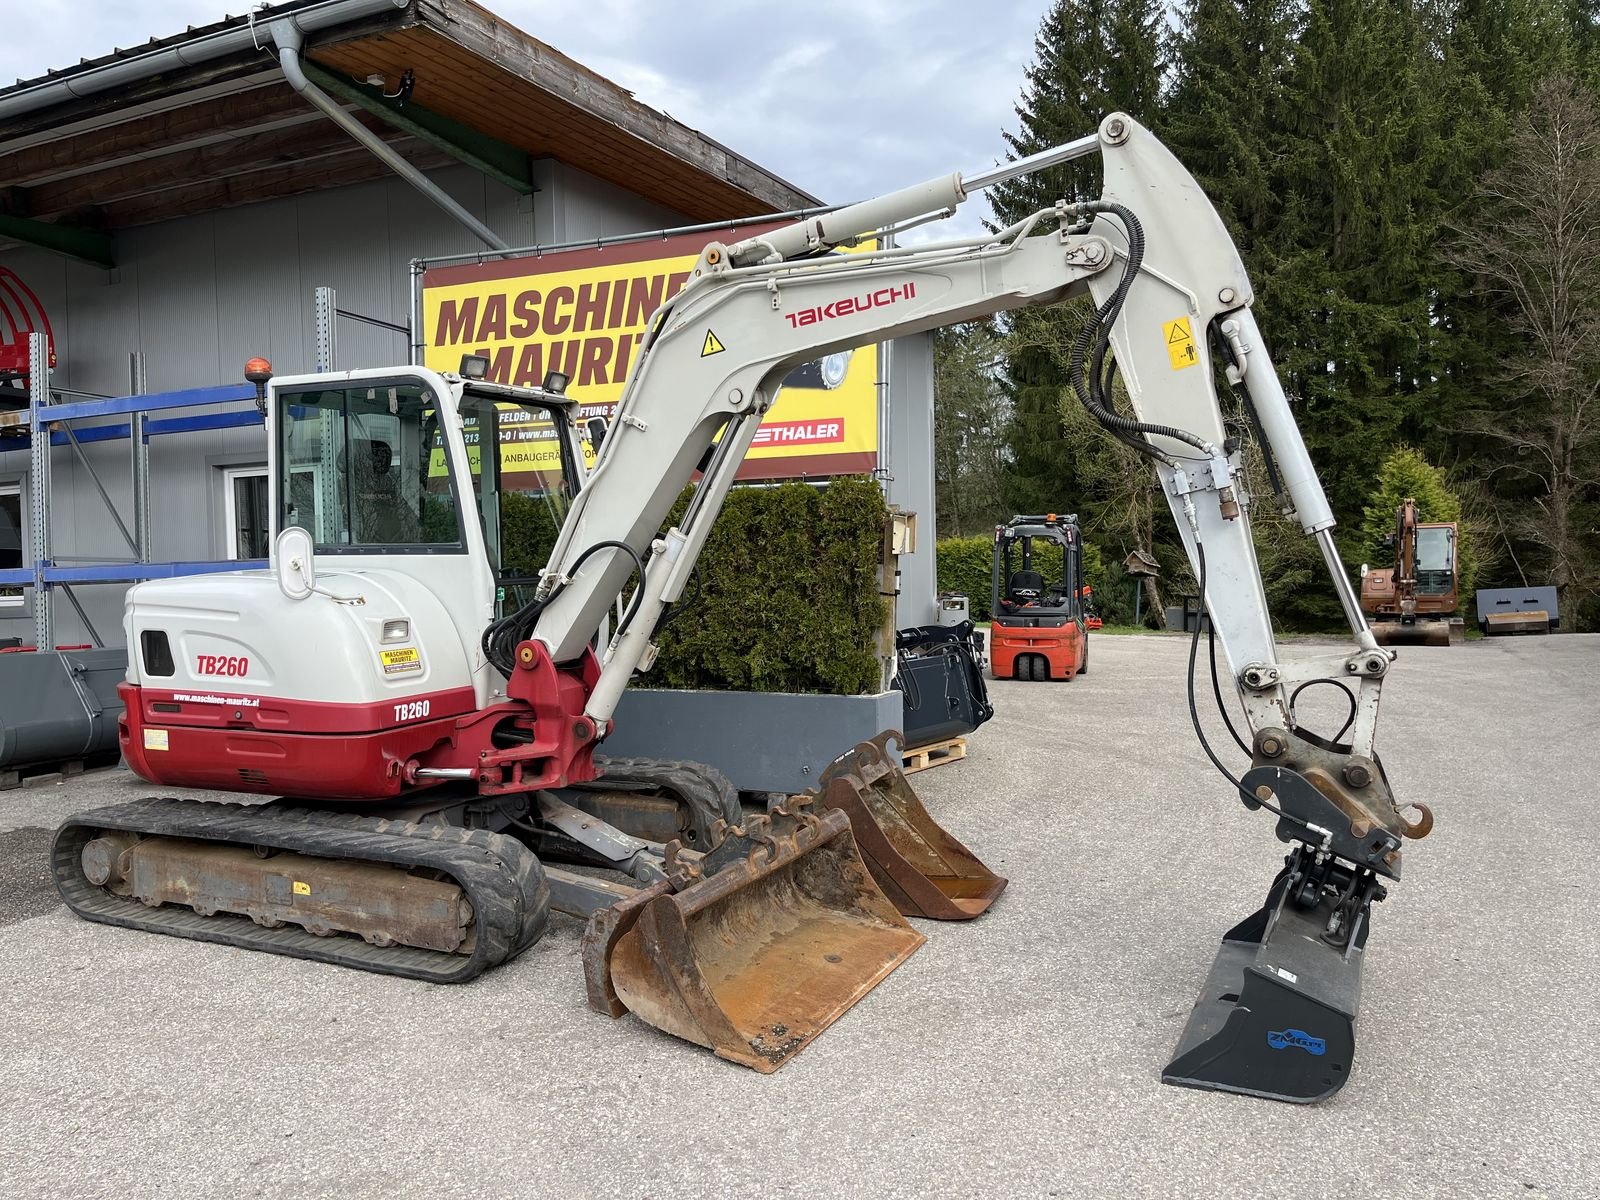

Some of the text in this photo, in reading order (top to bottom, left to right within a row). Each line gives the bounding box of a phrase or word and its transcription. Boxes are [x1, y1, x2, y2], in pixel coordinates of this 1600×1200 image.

[785, 283, 916, 329] TAKEUCHI
[771, 423, 839, 441] THALER
[197, 655, 249, 677] TB260
[173, 693, 260, 707] www.maschinen-mauritz.at
[393, 700, 430, 722] TB260
